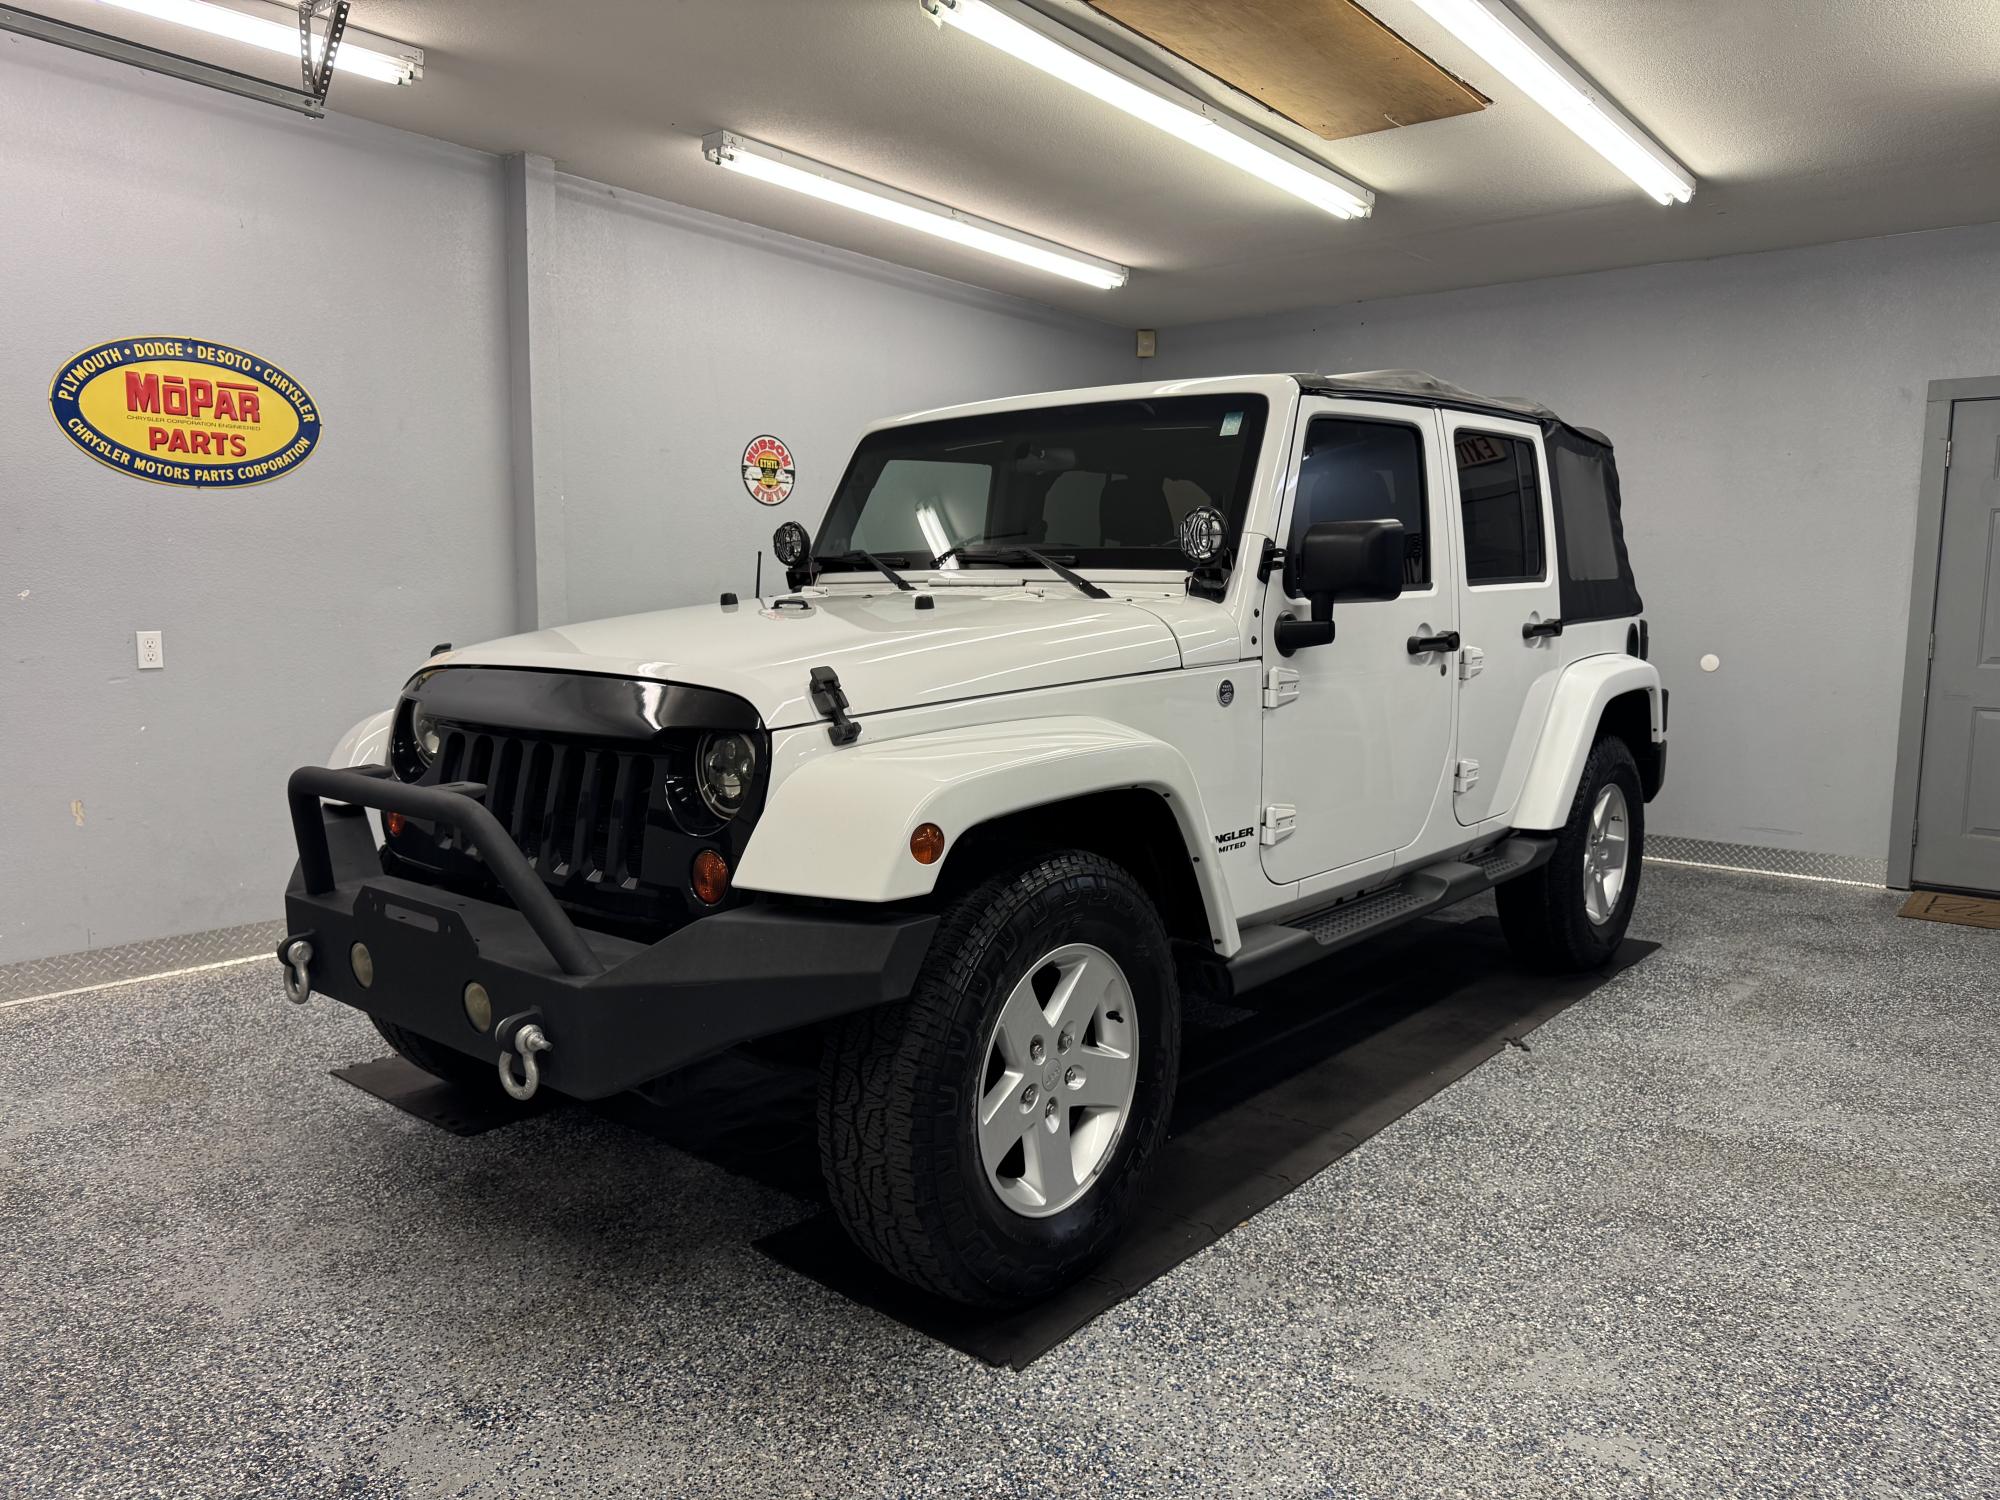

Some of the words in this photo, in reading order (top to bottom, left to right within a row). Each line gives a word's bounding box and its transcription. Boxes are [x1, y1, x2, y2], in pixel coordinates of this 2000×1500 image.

[58, 347, 122, 401] PLYMOUTH
[133, 342, 183, 358] DODGE
[263, 367, 315, 423] CHRYSLER
[126, 414, 165, 424] CHRYSLER
[166, 418, 217, 428] CORPORATION
[218, 423, 261, 431] ENGINEERED
[67, 417, 130, 466] CHRYSLER
[134, 457, 190, 481] MOTORS
[195, 468, 234, 482] PARTS
[237, 436, 311, 480] CORPORATION
[149, 426, 246, 457] PARTS
[745, 439, 791, 467] HUDSON
[1215, 826, 1254, 843] NGLER
[1218, 841, 1246, 853] MITED
